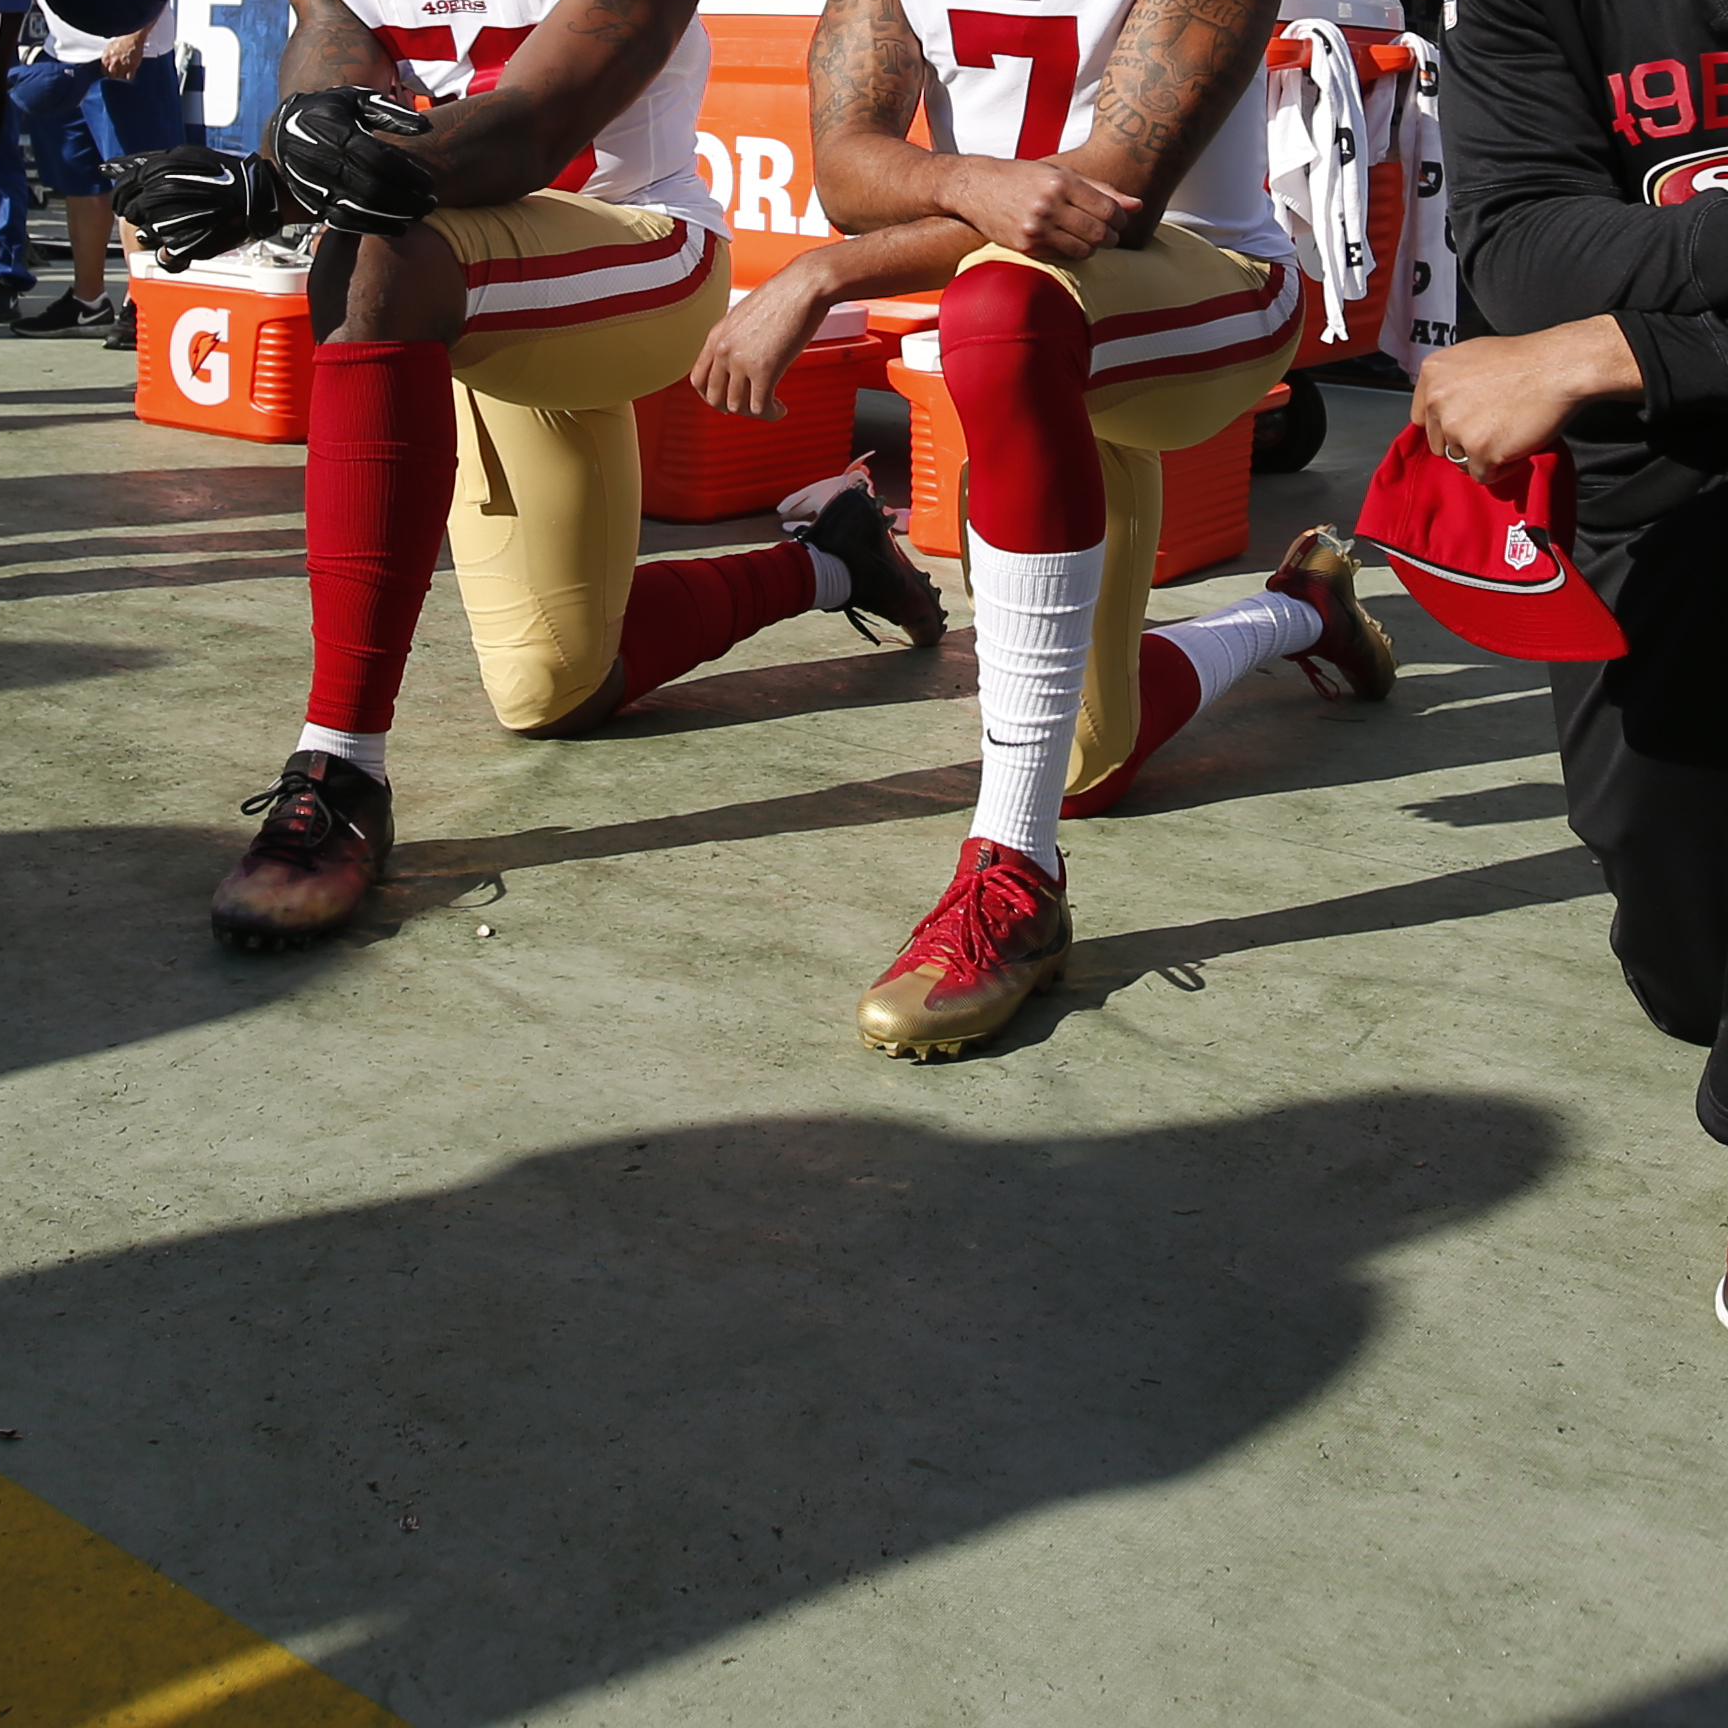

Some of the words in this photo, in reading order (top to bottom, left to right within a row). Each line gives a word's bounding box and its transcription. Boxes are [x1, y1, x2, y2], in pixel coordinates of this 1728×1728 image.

[422, 0, 488, 15] 49ERS
[947, 8, 1081, 162] 7
[169, 306, 232, 407] G
[1510, 540, 1534, 560] NFL
